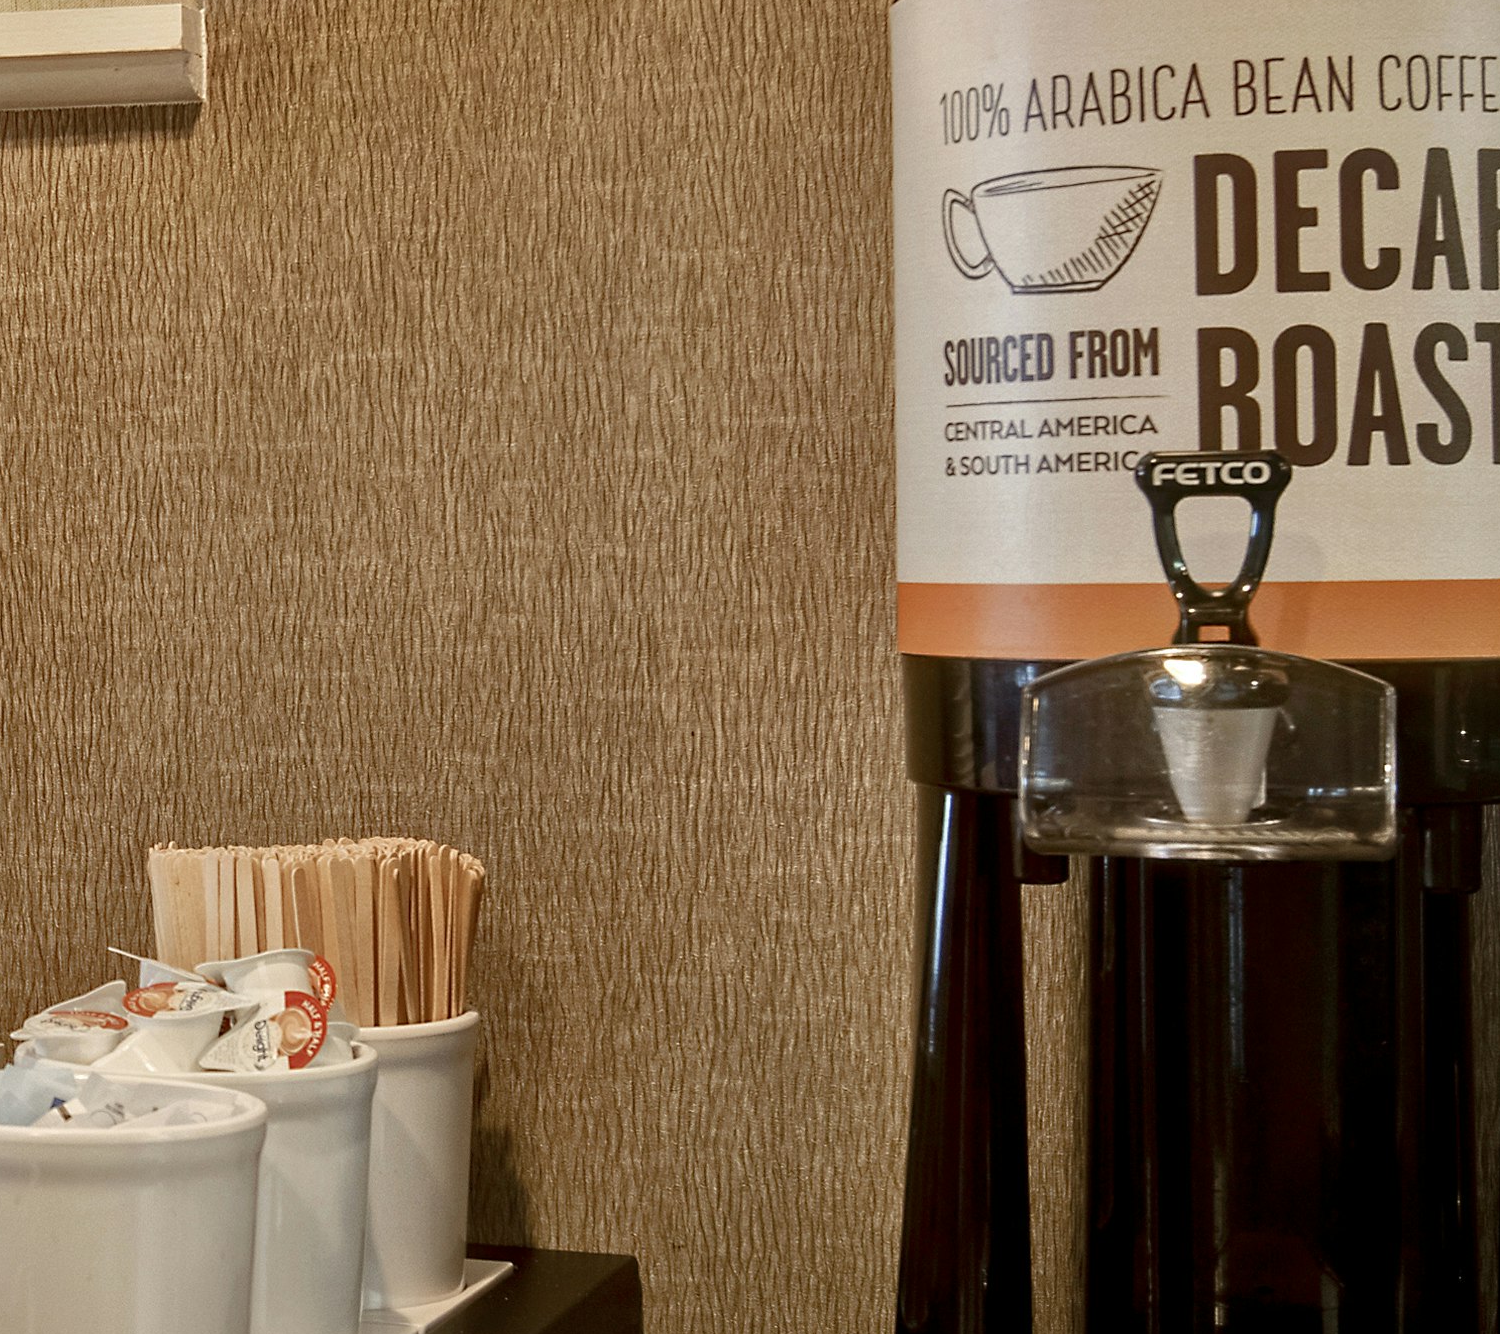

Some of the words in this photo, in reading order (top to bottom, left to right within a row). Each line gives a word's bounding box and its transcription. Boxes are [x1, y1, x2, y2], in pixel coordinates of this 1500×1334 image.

[940, 82, 1010, 145] 100%
[1023, 63, 1211, 133] ARABICA
[1233, 55, 1355, 117] BEAN
[944, 332, 1055, 386] SOURCED
[1068, 327, 1160, 380] FROM
[944, 419, 1033, 442] CENTRAL
[1037, 414, 1159, 439] AMERICA
[945, 457, 956, 476] &
[961, 454, 1031, 476] SOUTH
[1036, 450, 1140, 473] AMERIC
[1153, 461, 1271, 486] FETCO
